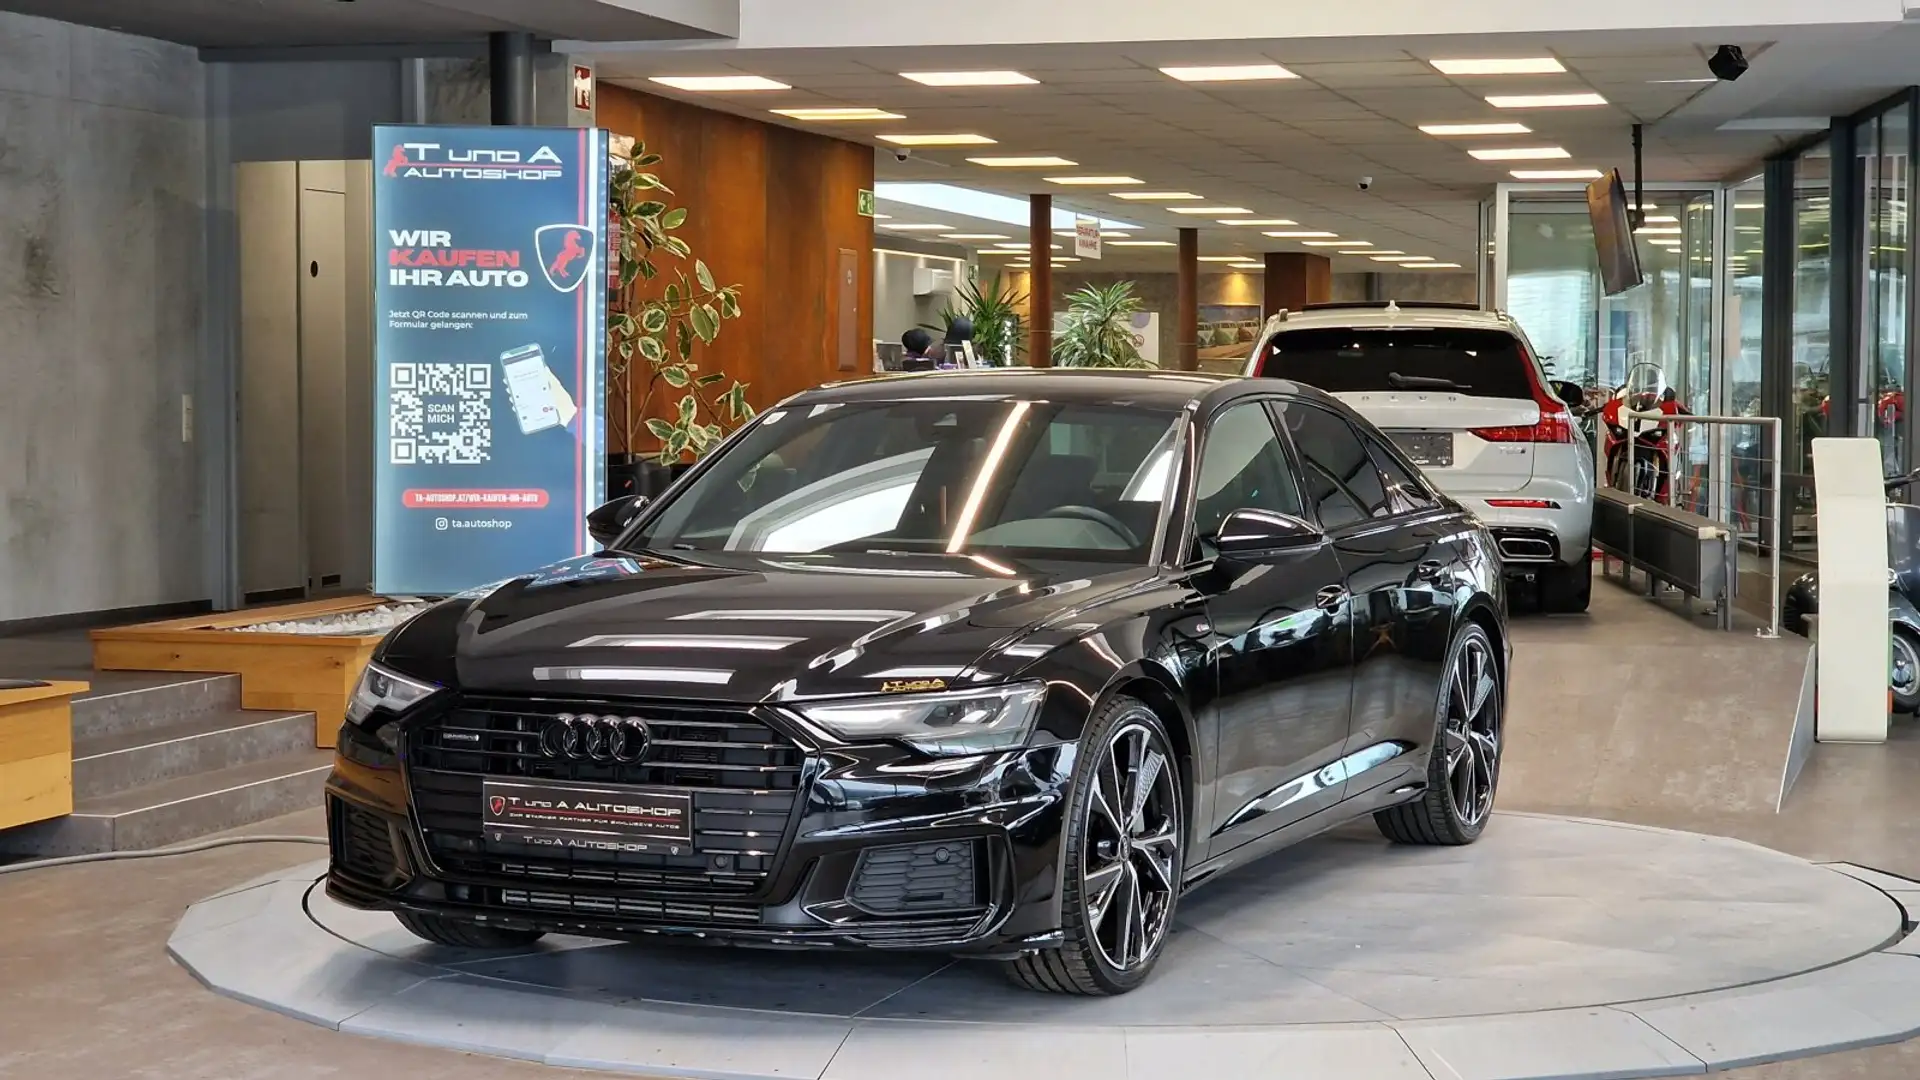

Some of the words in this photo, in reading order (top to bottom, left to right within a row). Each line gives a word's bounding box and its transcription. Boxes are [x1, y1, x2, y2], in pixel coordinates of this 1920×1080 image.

[403, 143, 440, 161] T
[527, 146, 563, 163] A
[403, 167, 563, 180] AUTOSHOP
[389, 230, 451, 247] WIR
[389, 249, 520, 267] KAUFEN
[389, 269, 442, 286] IHR
[445, 270, 529, 287] AUTO
[388, 310, 411, 319] Jetzt
[411, 310, 426, 319] QR
[427, 310, 450, 319] Code
[451, 311, 488, 319] scannen
[489, 311, 507, 319] und
[389, 320, 429, 329] Formular
[430, 320, 474, 330] gelangen:
[427, 404, 455, 413] SCAN
[427, 414, 455, 423] MICH
[452, 518, 512, 530] ta.autoshop
[508, 797, 521, 805] T
[556, 800, 569, 809] A
[574, 801, 682, 816] AUTOSHOP
[553, 838, 564, 846] A
[567, 839, 648, 852] AUTOSHOP
